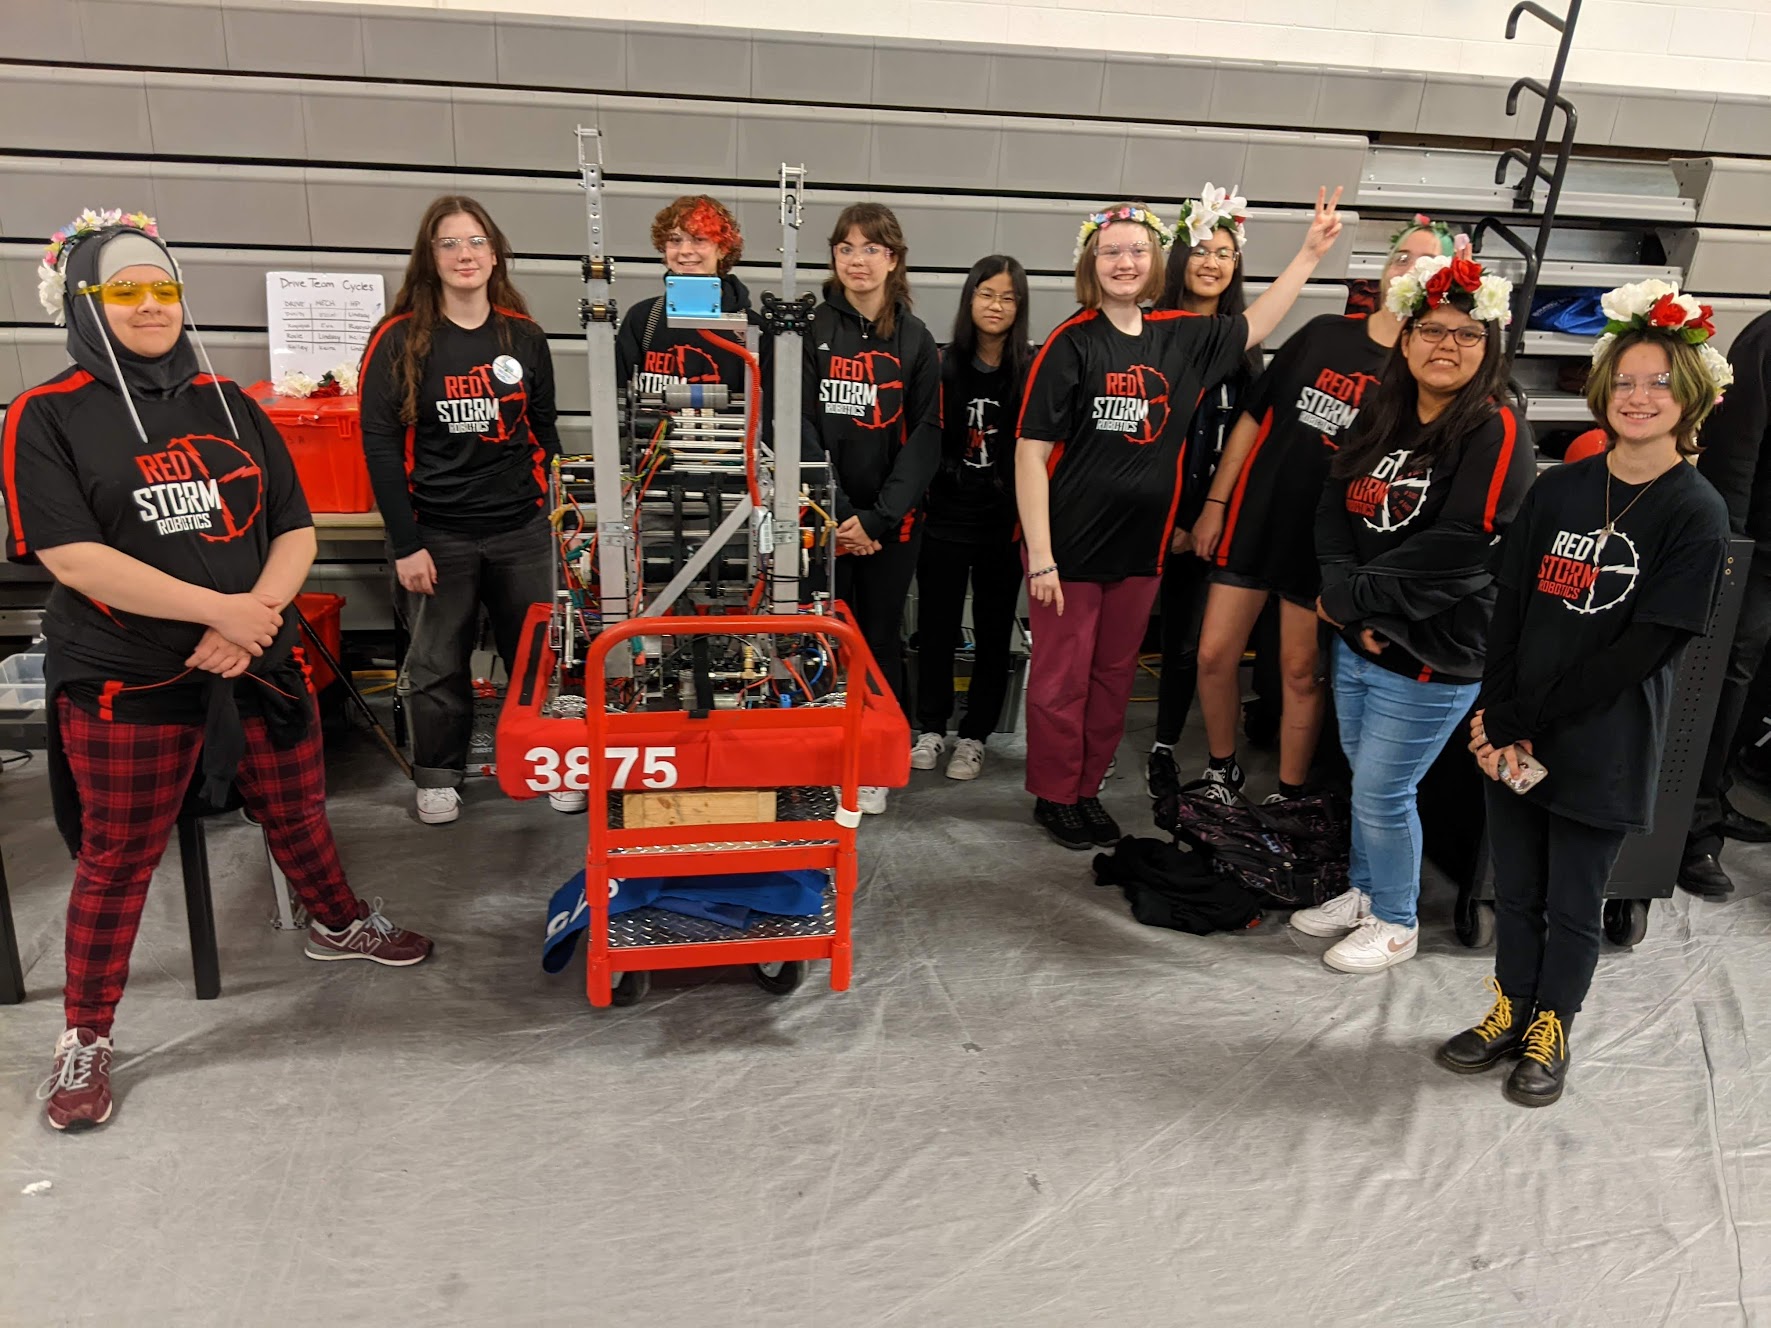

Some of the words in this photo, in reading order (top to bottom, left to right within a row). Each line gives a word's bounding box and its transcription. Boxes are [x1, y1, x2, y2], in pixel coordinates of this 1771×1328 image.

[280, 277, 307, 289] Drive
[307, 277, 335, 288] Team
[342, 280, 374, 292] Cycles
[829, 355, 865, 381] RED
[444, 375, 484, 399] RED
[818, 378, 878, 407] STORM
[1105, 372, 1138, 397] RED
[1314, 368, 1355, 402] RED
[435, 397, 500, 423] STORM
[825, 402, 866, 417] ROBOTICS
[1091, 396, 1149, 422] STORM
[1295, 386, 1360, 429] STORM
[448, 421, 490, 434] ROBOTICS
[1096, 419, 1138, 433] ROBOTICS
[134, 450, 193, 484] RED
[132, 478, 223, 522] STORM
[156, 512, 212, 536] ROBOTICS
[1551, 530, 1595, 561] RED
[1537, 554, 1600, 589] STORM
[1537, 579, 1581, 600] ROBOTICS
[524, 746, 678, 792] 3875
